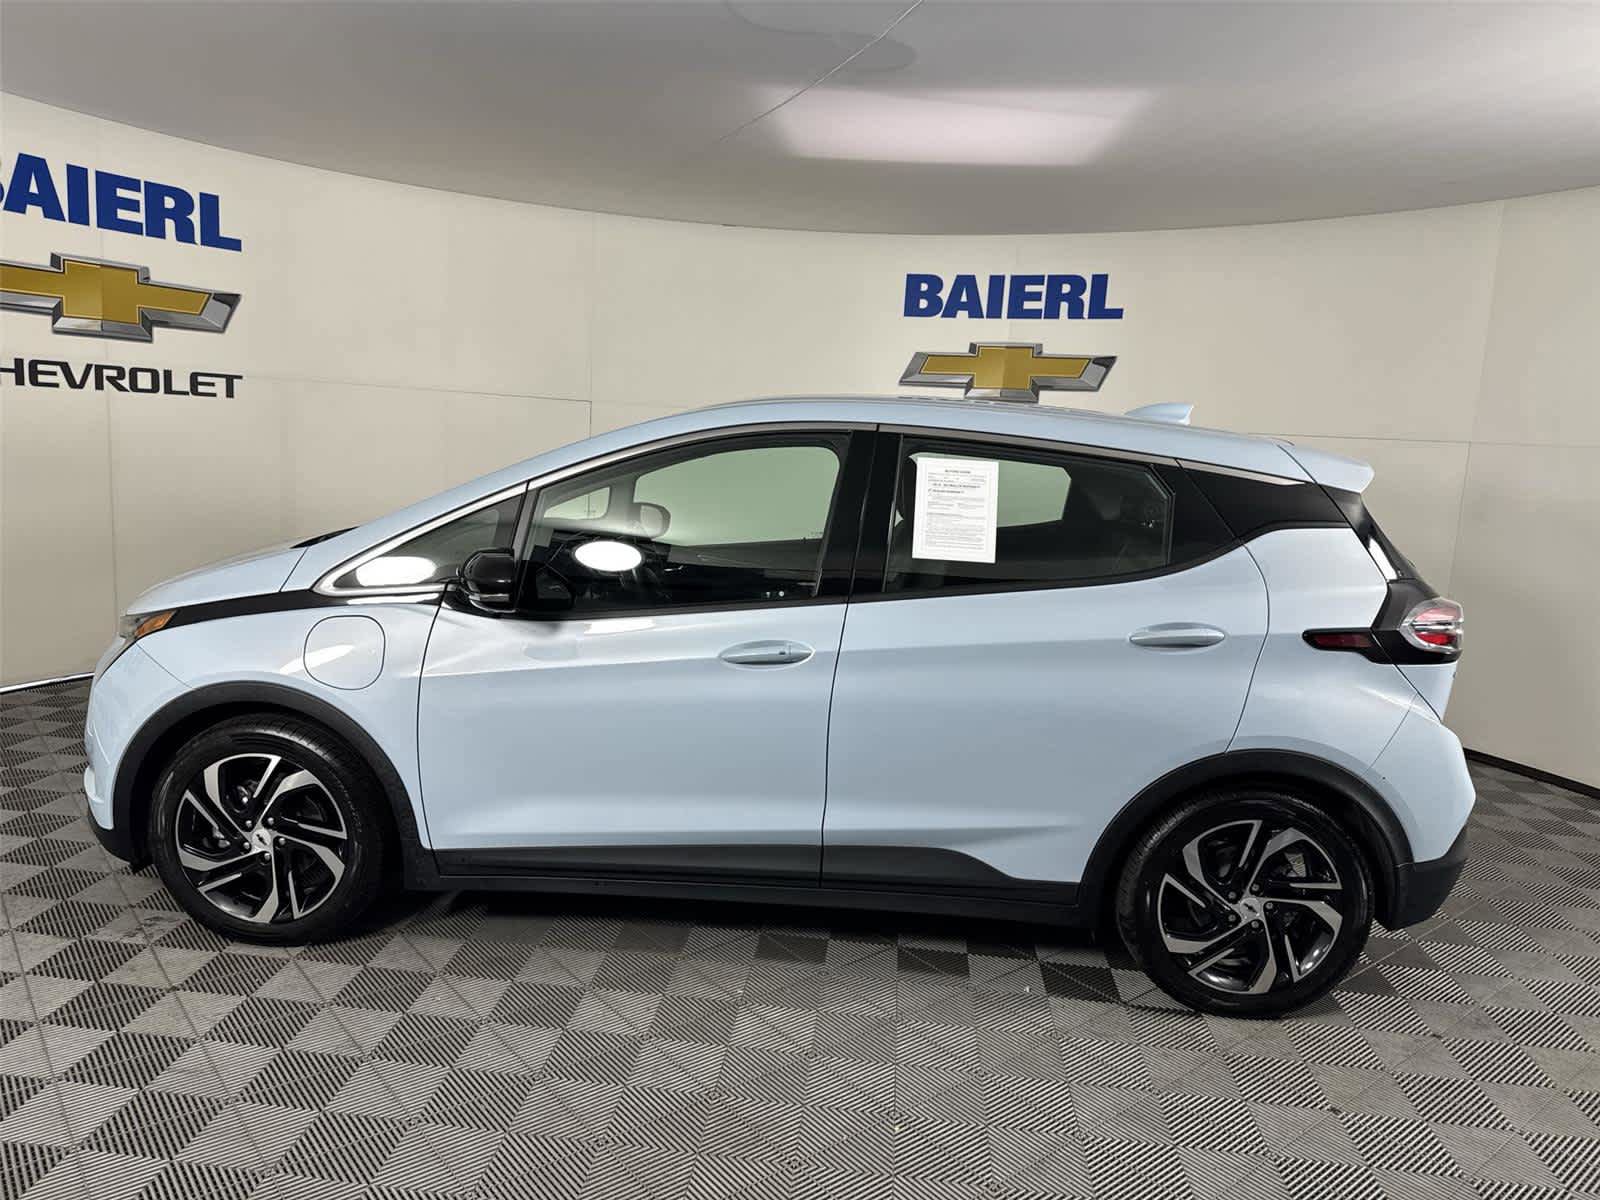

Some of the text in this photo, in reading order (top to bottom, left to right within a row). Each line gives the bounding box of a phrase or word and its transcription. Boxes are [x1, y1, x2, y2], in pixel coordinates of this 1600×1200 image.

[0, 152, 242, 252] AIERL
[903, 273, 1124, 320] BAIERL
[0, 357, 243, 399] HEVROLET
